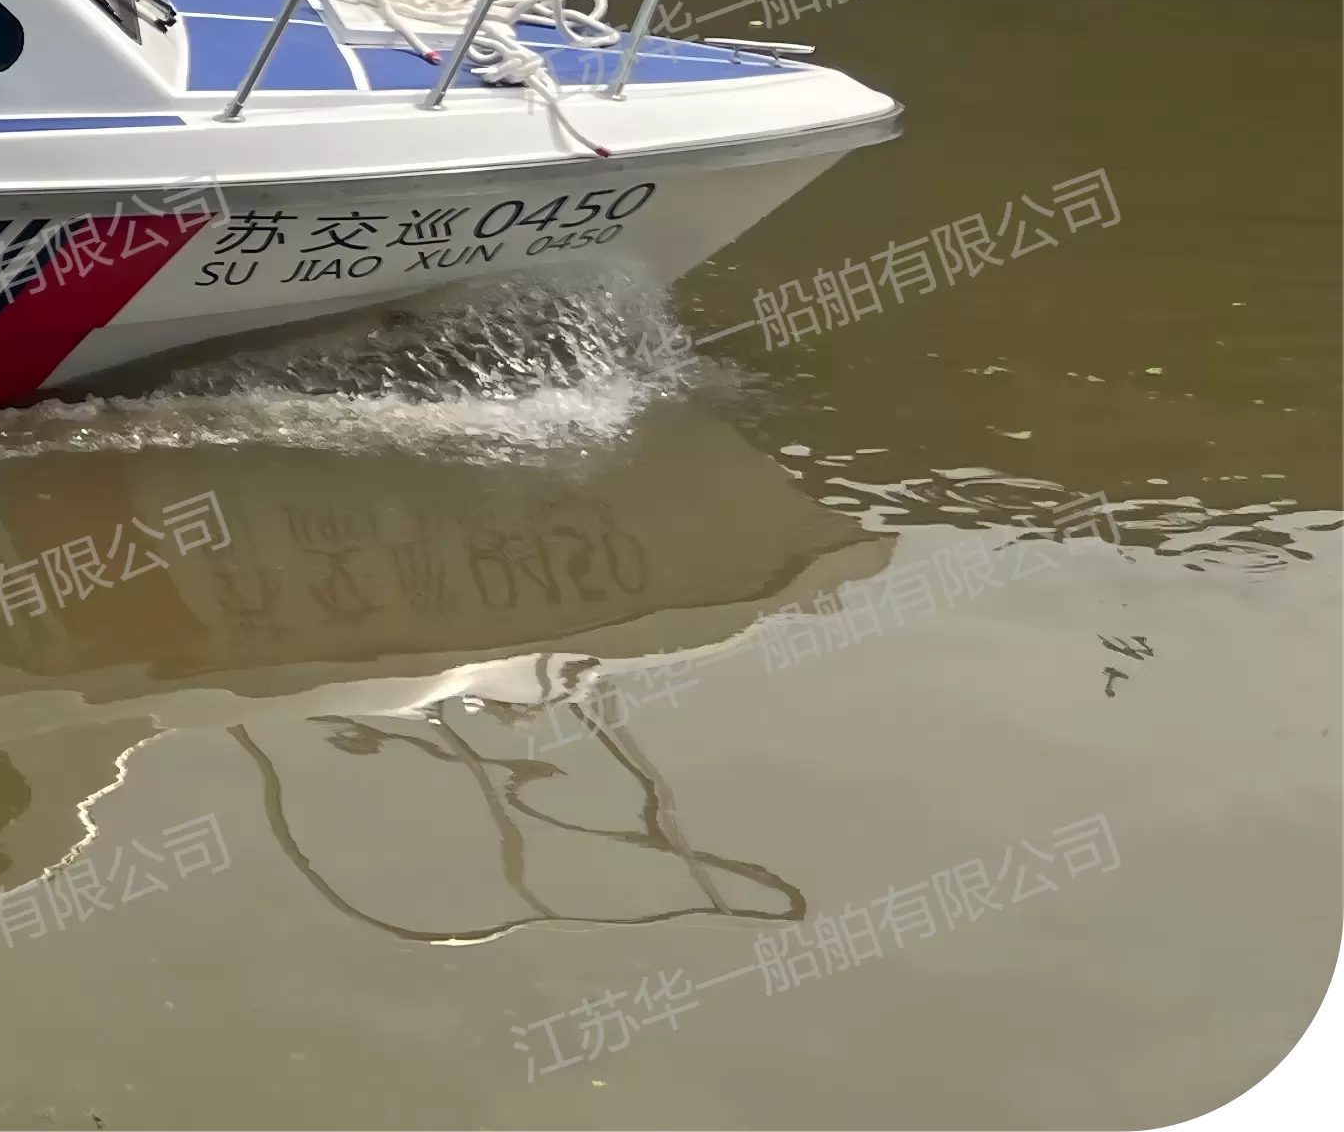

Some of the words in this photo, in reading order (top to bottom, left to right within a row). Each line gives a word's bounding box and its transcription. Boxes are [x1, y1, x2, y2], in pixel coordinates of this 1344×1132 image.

[194, 261, 258, 286] SU
[281, 256, 383, 283] JIAO
[406, 242, 505, 272] XUN
[525, 224, 624, 256] 0450
